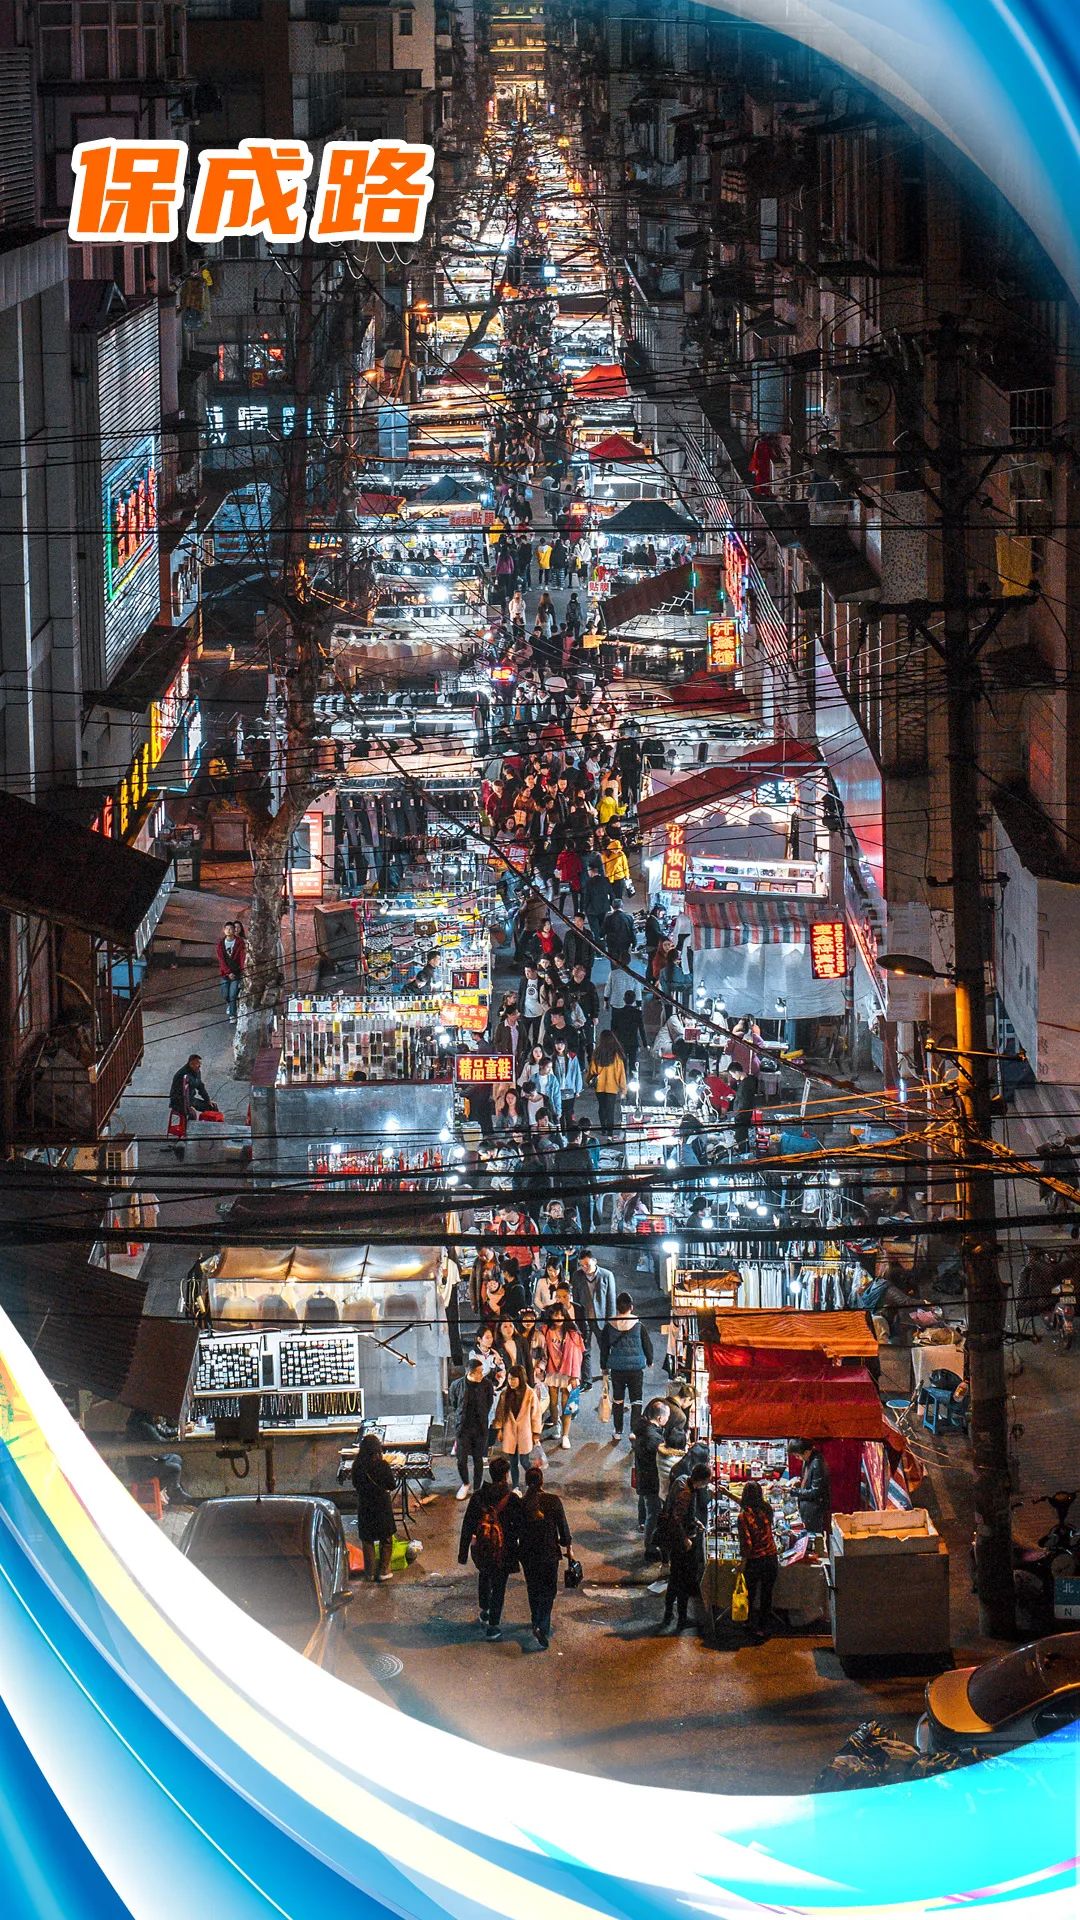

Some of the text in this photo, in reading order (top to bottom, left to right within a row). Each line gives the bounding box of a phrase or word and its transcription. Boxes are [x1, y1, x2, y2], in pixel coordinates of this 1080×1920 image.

[667, 829, 685, 888] 化妆品
[459, 1057, 511, 1081] 精品童鞋
[1064, 1607, 1072, 1616] N
